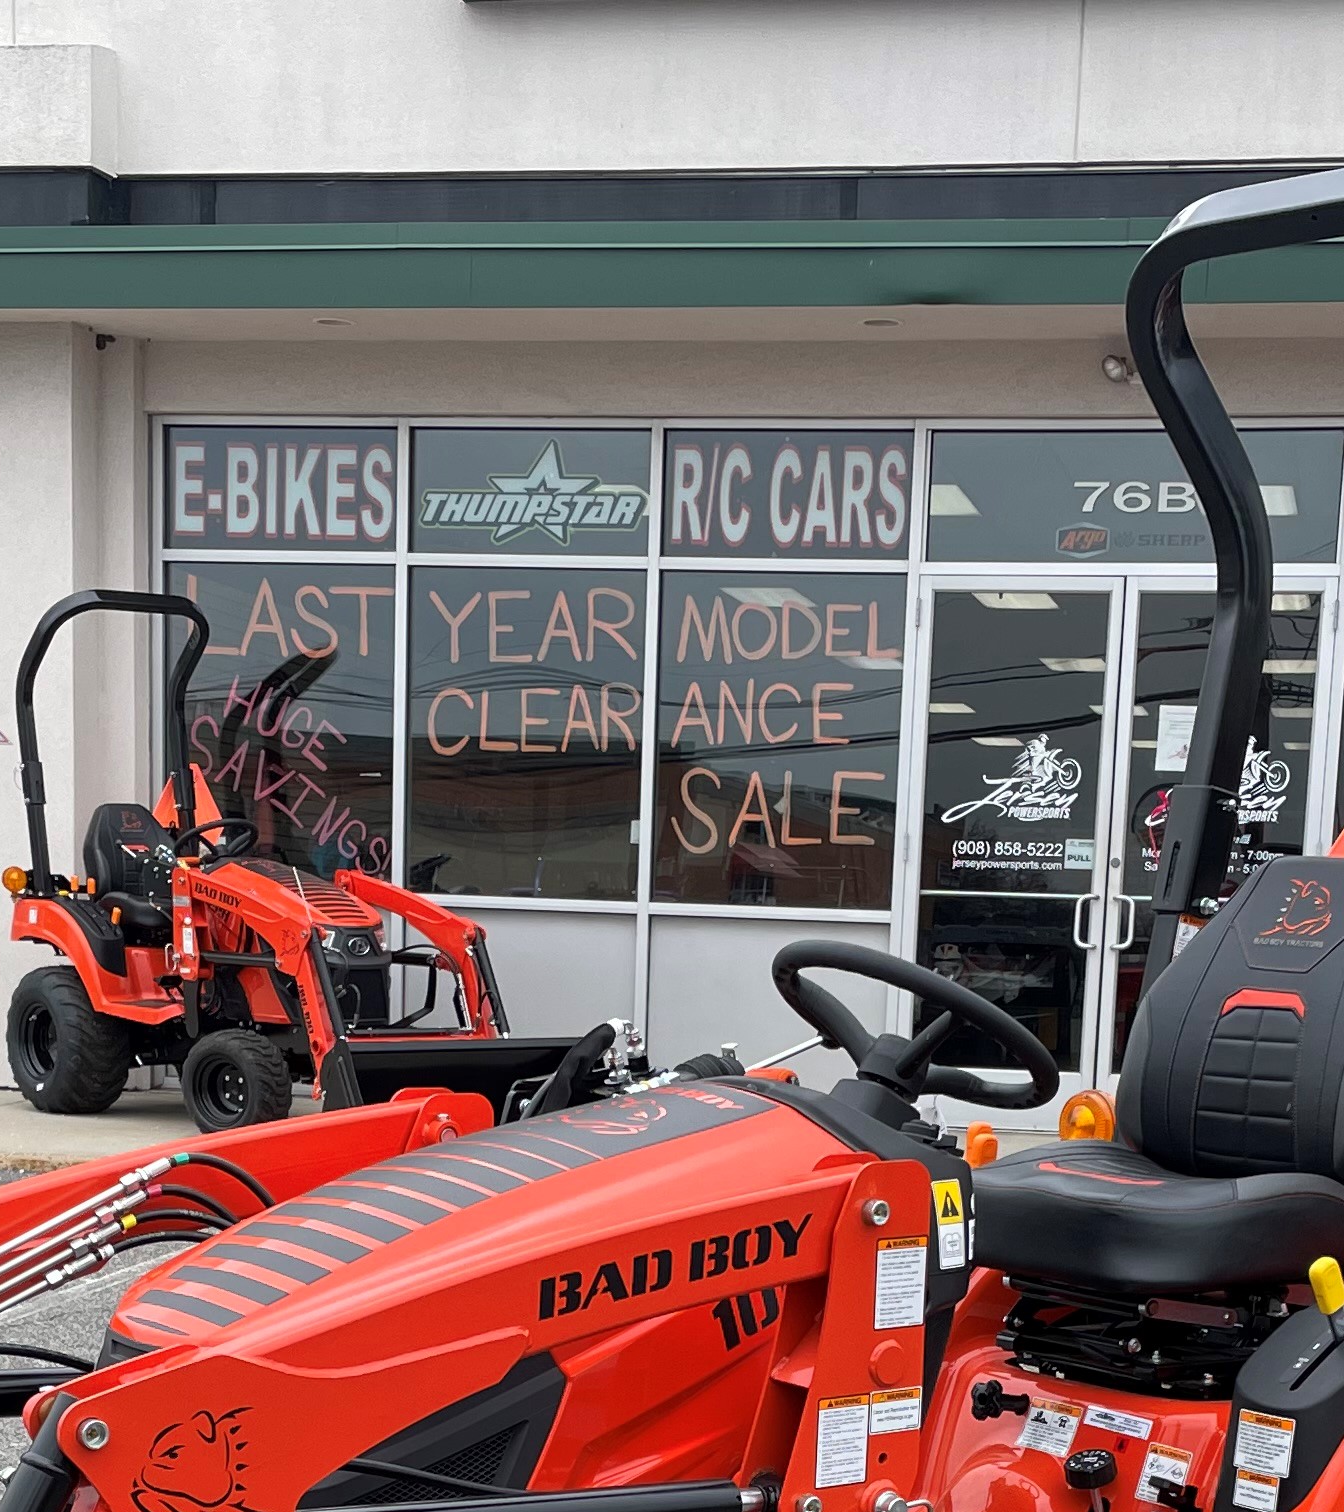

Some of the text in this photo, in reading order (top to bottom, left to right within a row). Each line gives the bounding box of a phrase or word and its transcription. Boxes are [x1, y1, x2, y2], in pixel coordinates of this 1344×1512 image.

[173, 441, 394, 542] E-BIKES
[421, 492, 637, 527] THUMPSTAR
[669, 443, 908, 549] R/C CARS
[1059, 530, 1207, 551] Argo SHERP
[186, 574, 902, 664] LAST YEAR MODEL
[222, 674, 348, 773] HUGE
[670, 767, 886, 855] SALE
[941, 774, 1080, 824] Jersey
[1008, 806, 1071, 821] POWERSPORTS
[952, 840, 1064, 857] (908) 858-5222
[952, 858, 1063, 872] jerseypowersports.com
[1067, 854, 1092, 863] PULL
[537, 1213, 814, 1322] BAD BOY
